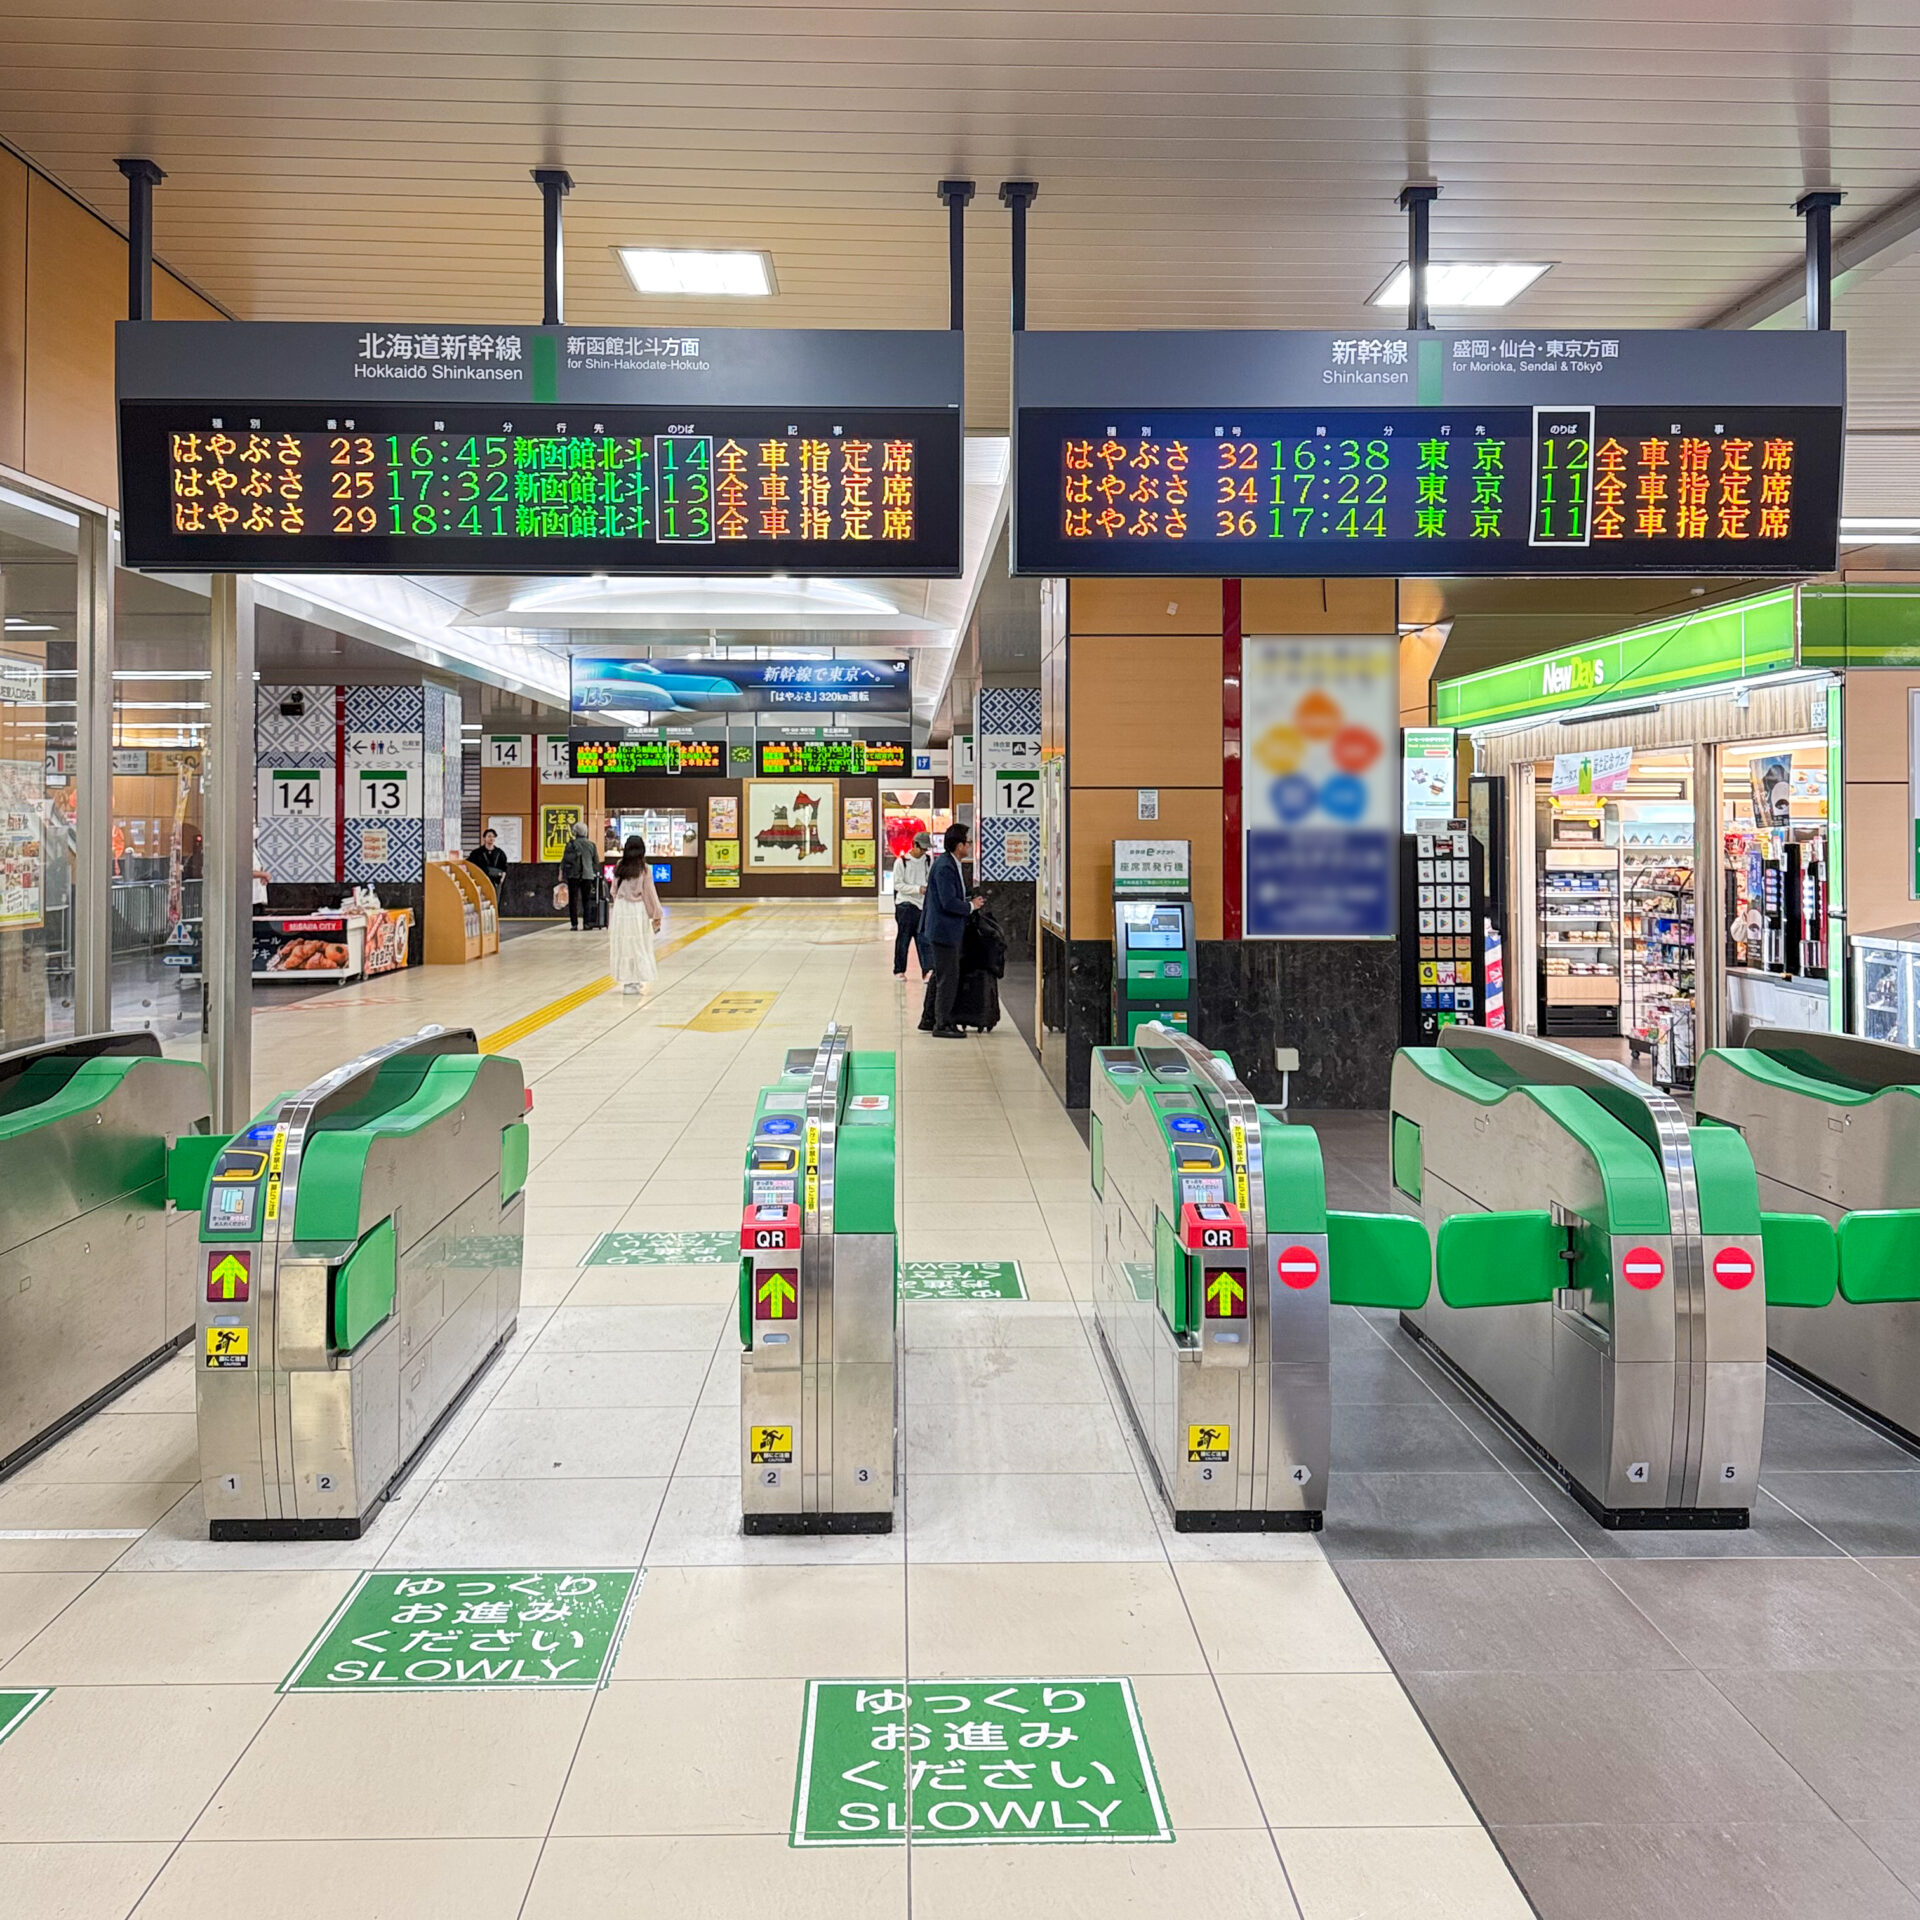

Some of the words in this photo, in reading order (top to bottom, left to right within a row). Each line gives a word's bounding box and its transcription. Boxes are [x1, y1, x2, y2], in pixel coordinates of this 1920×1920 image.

[358, 333, 522, 361] 北海道新幹線
[567, 336, 699, 357] 新函館北斗方面
[1331, 340, 1408, 365] 新幹線
[1452, 340, 1620, 358] 盛岡・仙台・東京方面
[354, 363, 426, 380] Hokkaidō
[431, 364, 523, 381] Shinkansen
[567, 358, 582, 370] for
[584, 359, 710, 371] Shin-Hakodate-Hokuto
[1452, 361, 1466, 372] for
[1470, 361, 1516, 373] Morioka,
[1519, 361, 1558, 372] Sendai
[1561, 361, 1568, 372] &
[1570, 361, 1603, 374] Tōkyō
[1322, 370, 1408, 384] Shinkansen
[667, 423, 695, 434] のりば
[1550, 424, 1578, 435] のりば
[172, 433, 302, 464] はやぶさ
[329, 437, 375, 465] 23
[386, 435, 508, 467] 16:45
[513, 436, 650, 470] 新函館北斗
[662, 438, 709, 470] 14
[716, 439, 914, 472] 全車指定席
[1065, 440, 1189, 470] はやぶさ
[1218, 443, 1258, 469] 32
[1271, 440, 1390, 471] 16:38
[1417, 438, 1505, 471] 東京
[1542, 439, 1589, 470] 12
[1596, 438, 1794, 471] 全車指定席
[174, 468, 304, 499] はやぶさ
[331, 472, 375, 499] 25
[387, 470, 509, 502] 17:32
[514, 472, 650, 504] 新函館北斗
[663, 474, 709, 504] 13
[716, 474, 914, 506] 全車指定席
[1065, 475, 1188, 504] はやぶさ
[1217, 476, 1258, 503] 34
[1270, 474, 1388, 504] 17:22
[1415, 473, 1504, 505] 東京
[1540, 473, 1585, 503] 11
[1594, 472, 1793, 505] 全車指定席
[175, 502, 305, 532] はやぶさ
[332, 505, 377, 533] 29
[388, 504, 509, 535] 18:41
[515, 505, 651, 538] 新函館北斗
[664, 507, 709, 537] 13
[717, 507, 914, 540] 全車指定席
[1065, 509, 1187, 537] はやぶさ
[1216, 510, 1257, 537] 36
[1269, 508, 1386, 538] 17:44
[1413, 507, 1503, 540] 東京
[1539, 507, 1584, 537] 11
[1593, 507, 1791, 540] 全車指定席
[763, 666, 881, 682] 新幹線で東京へ。
[1542, 657, 1604, 695] NewDays
[494, 744, 518, 761] 14
[551, 744, 569, 761] 13
[279, 783, 314, 808] 14
[366, 783, 400, 808] 13
[1003, 783, 1034, 808] 12
[549, 813, 576, 824] とまる
[319, 922, 337, 930] CITY
[757, 1231, 784, 1247] QR
[1204, 1230, 1231, 1246] QR
[897, 1290, 1001, 1298] ゆっく
[767, 1472, 777, 1484] 2
[858, 1470, 868, 1482] 3
[1202, 1469, 1213, 1480] 3
[1293, 1469, 1303, 1481] 4
[1634, 1466, 1644, 1479] 4
[1725, 1466, 1735, 1479] 5
[228, 1478, 236, 1489] 1
[321, 1477, 331, 1489] 2
[393, 1575, 598, 1597] ゆっくり
[390, 1600, 574, 1624] お進み
[351, 1629, 584, 1653] ください
[326, 1659, 579, 1681] SLOWLY
[855, 1687, 1086, 1715] ゆっくり
[870, 1721, 1079, 1752] お進み
[841, 1759, 1116, 1791] ください
[837, 1800, 1122, 1832] SLOWLY
